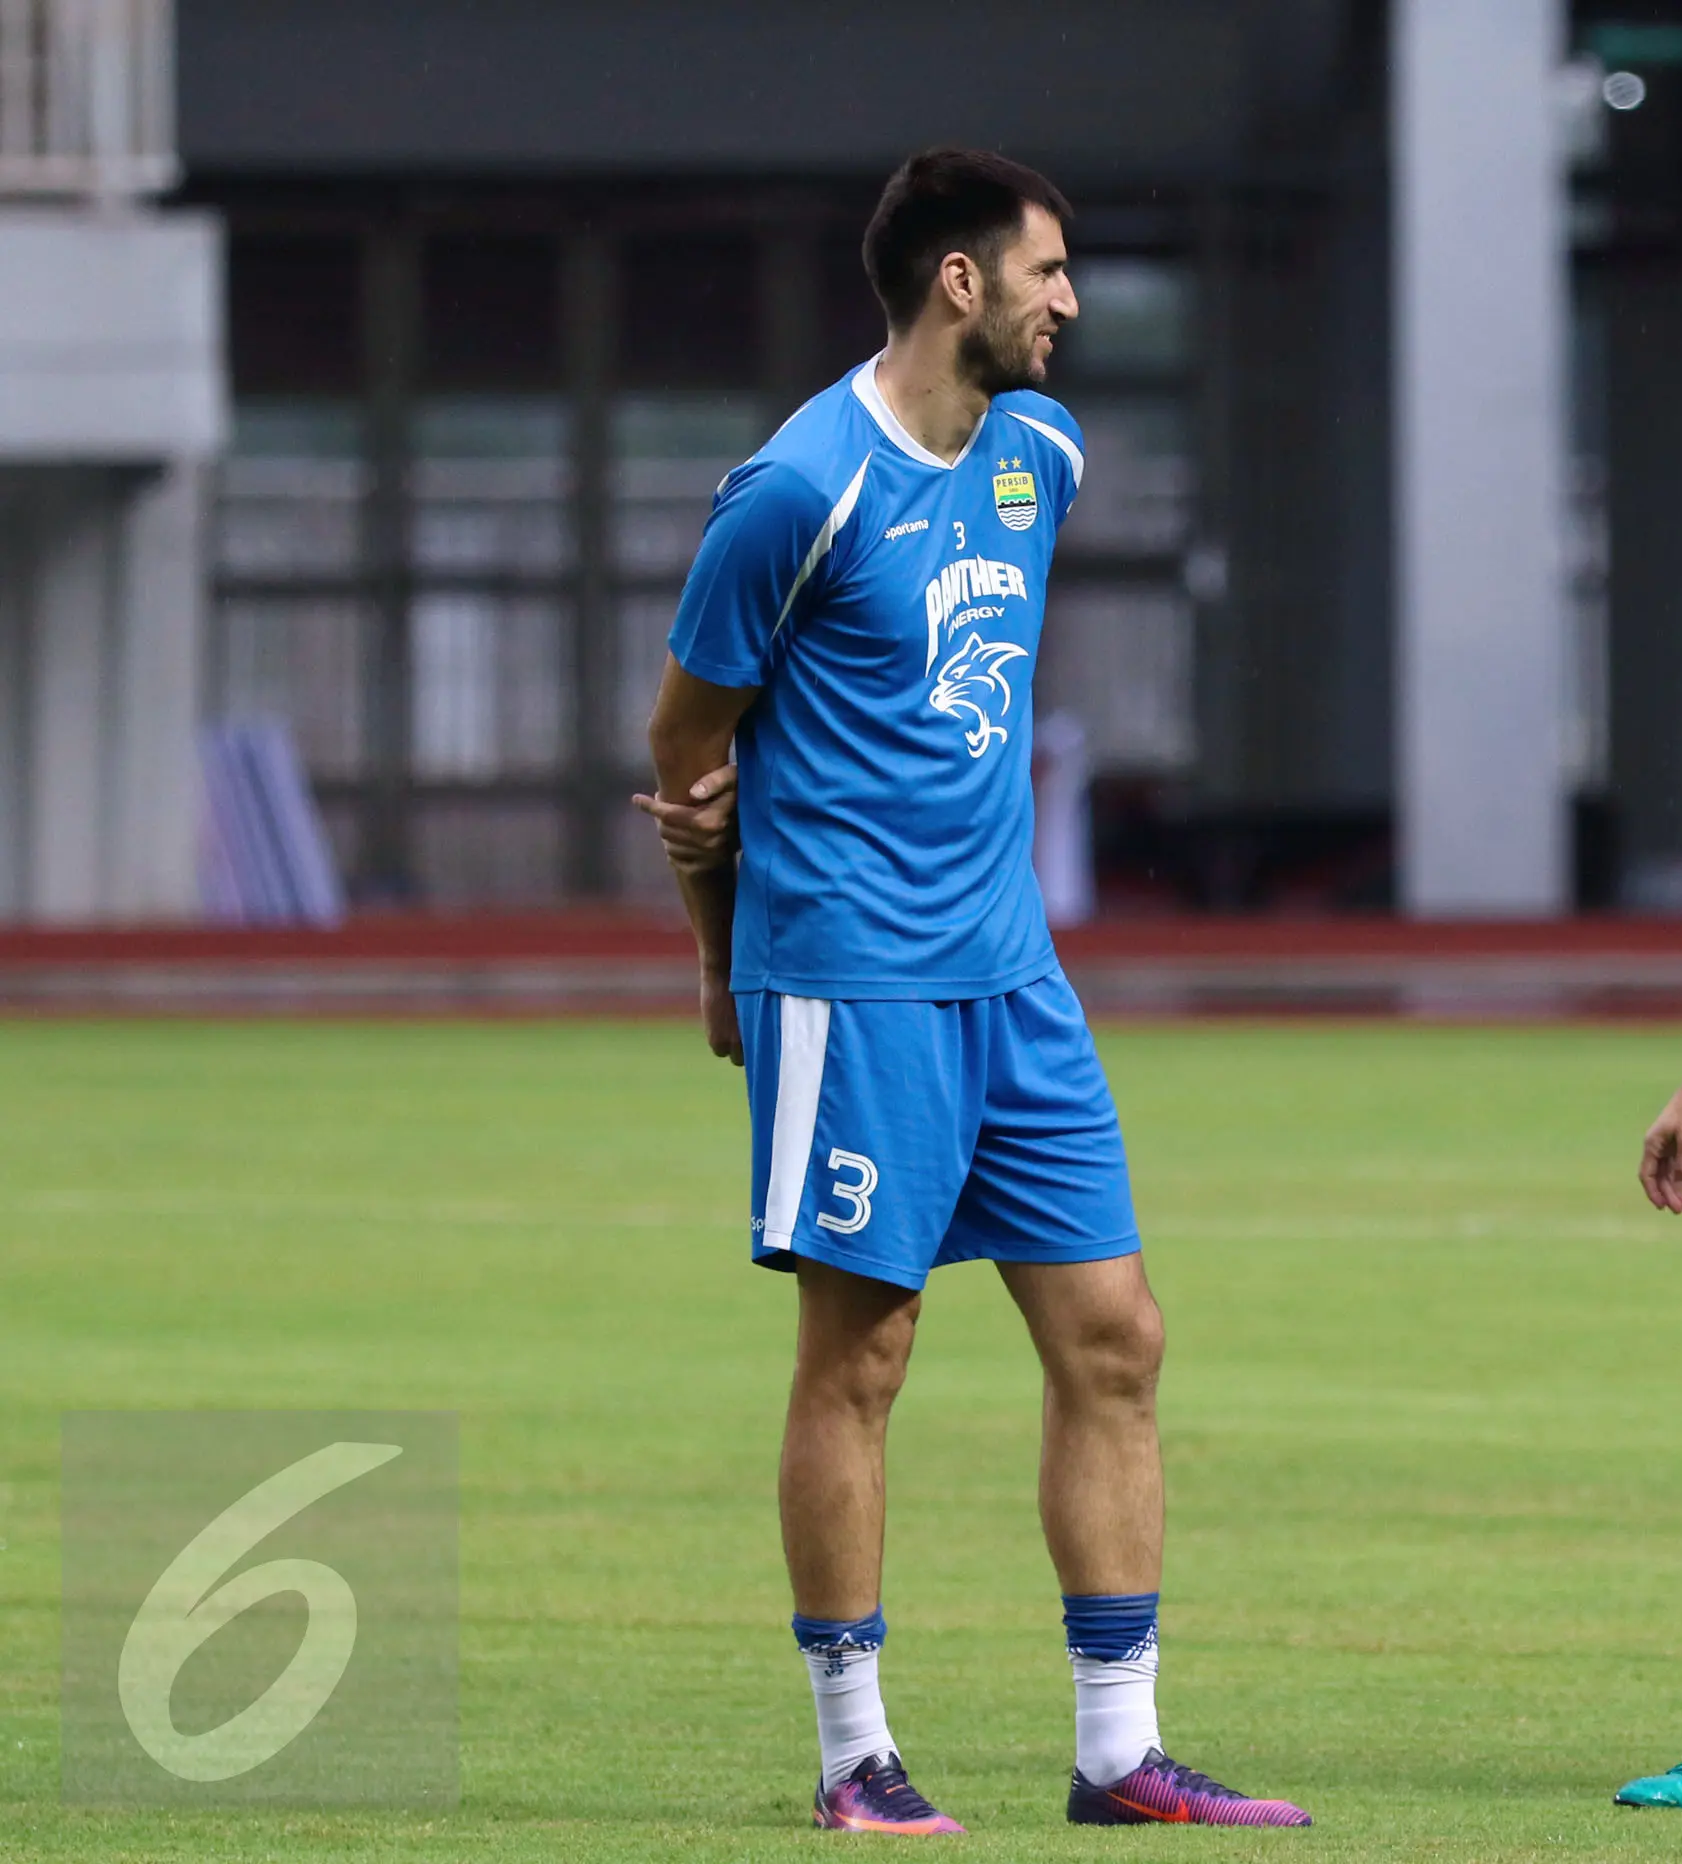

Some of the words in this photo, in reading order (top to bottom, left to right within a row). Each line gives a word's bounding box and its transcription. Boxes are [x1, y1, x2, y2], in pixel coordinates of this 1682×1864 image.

[996, 476, 1029, 488] PERSIB
[952, 521, 966, 550] 3
[925, 553, 1028, 678] PANTHER
[816, 1147, 879, 1235] 3
